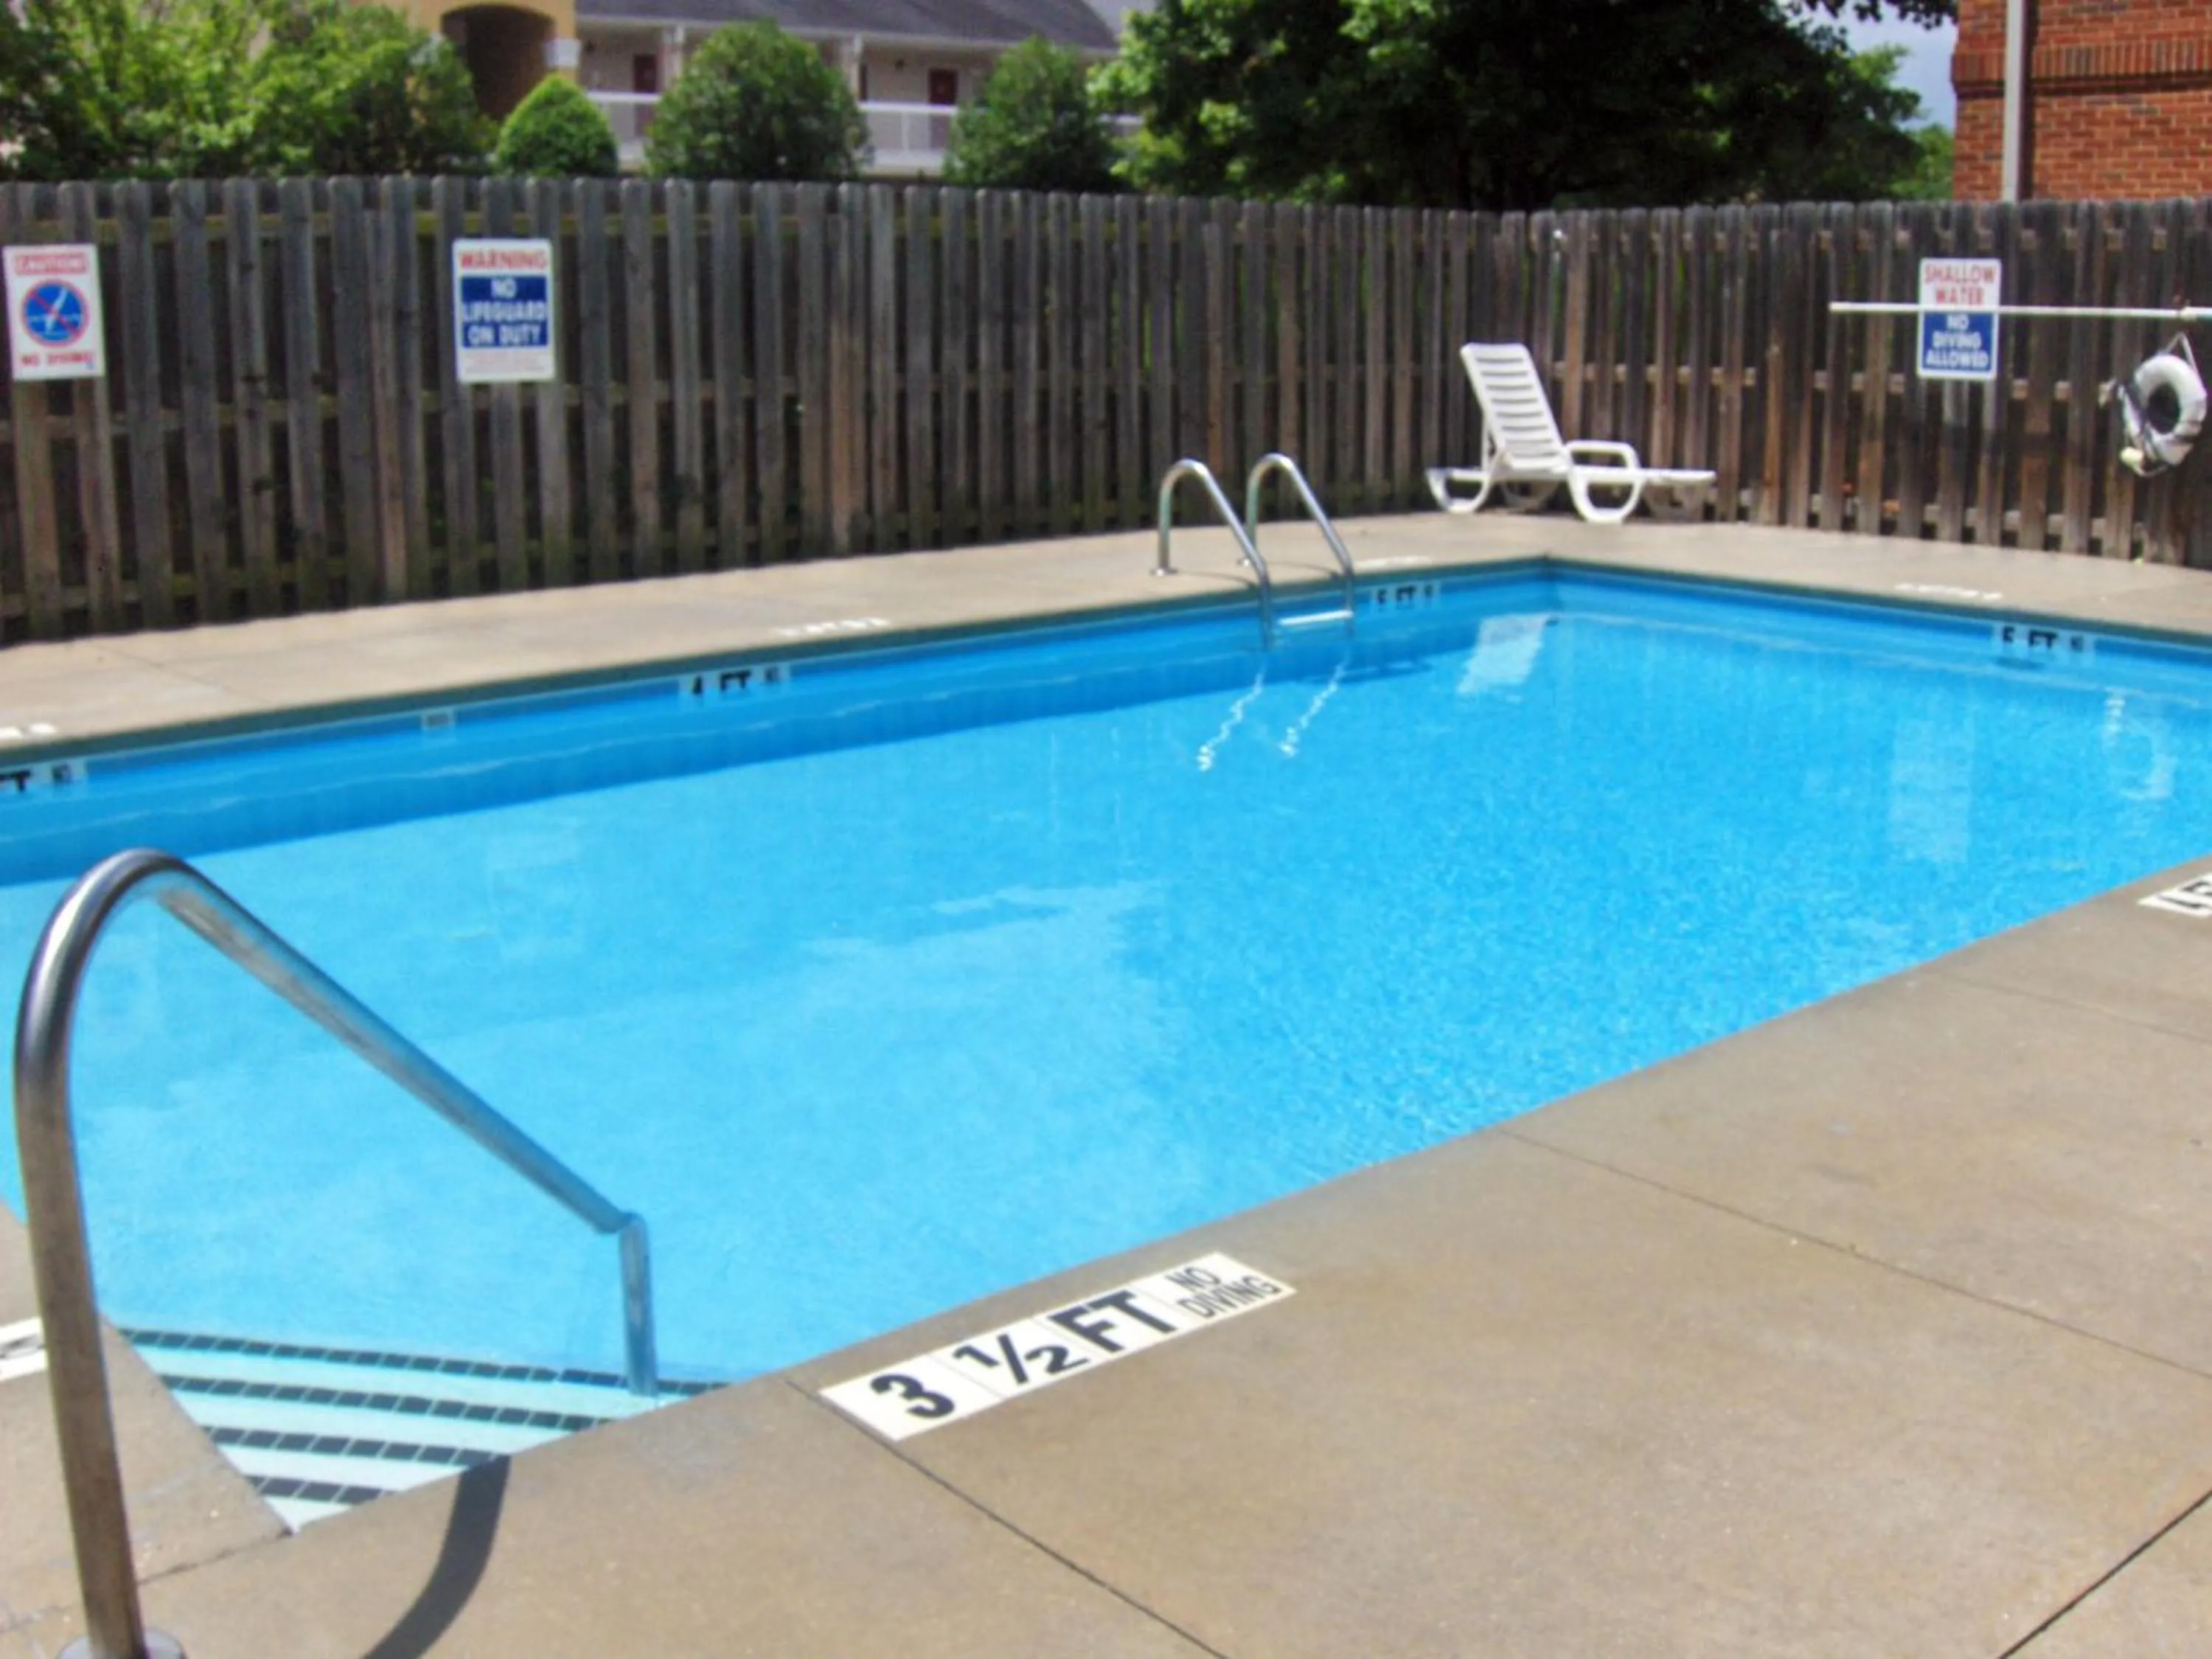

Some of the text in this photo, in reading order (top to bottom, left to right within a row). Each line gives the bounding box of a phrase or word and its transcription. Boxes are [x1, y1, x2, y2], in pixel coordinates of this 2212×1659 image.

[460, 251, 546, 270] WARNING
[1926, 265, 1994, 283] SHALLOW
[491, 278, 517, 298] NO
[1936, 287, 1984, 304] WATER
[462, 302, 546, 321] LIFEGUARD
[1947, 313, 1969, 331] NO
[468, 325, 540, 345] ON DUTY
[1933, 331, 1981, 349] DIVING
[1926, 349, 1989, 368] ALLOWED
[720, 669, 751, 692] FT
[1165, 1267, 1221, 1293] NO
[1177, 1276, 1282, 1318] DIVING
[870, 1374, 956, 1419] 3
[1046, 1290, 1177, 1352] FT
